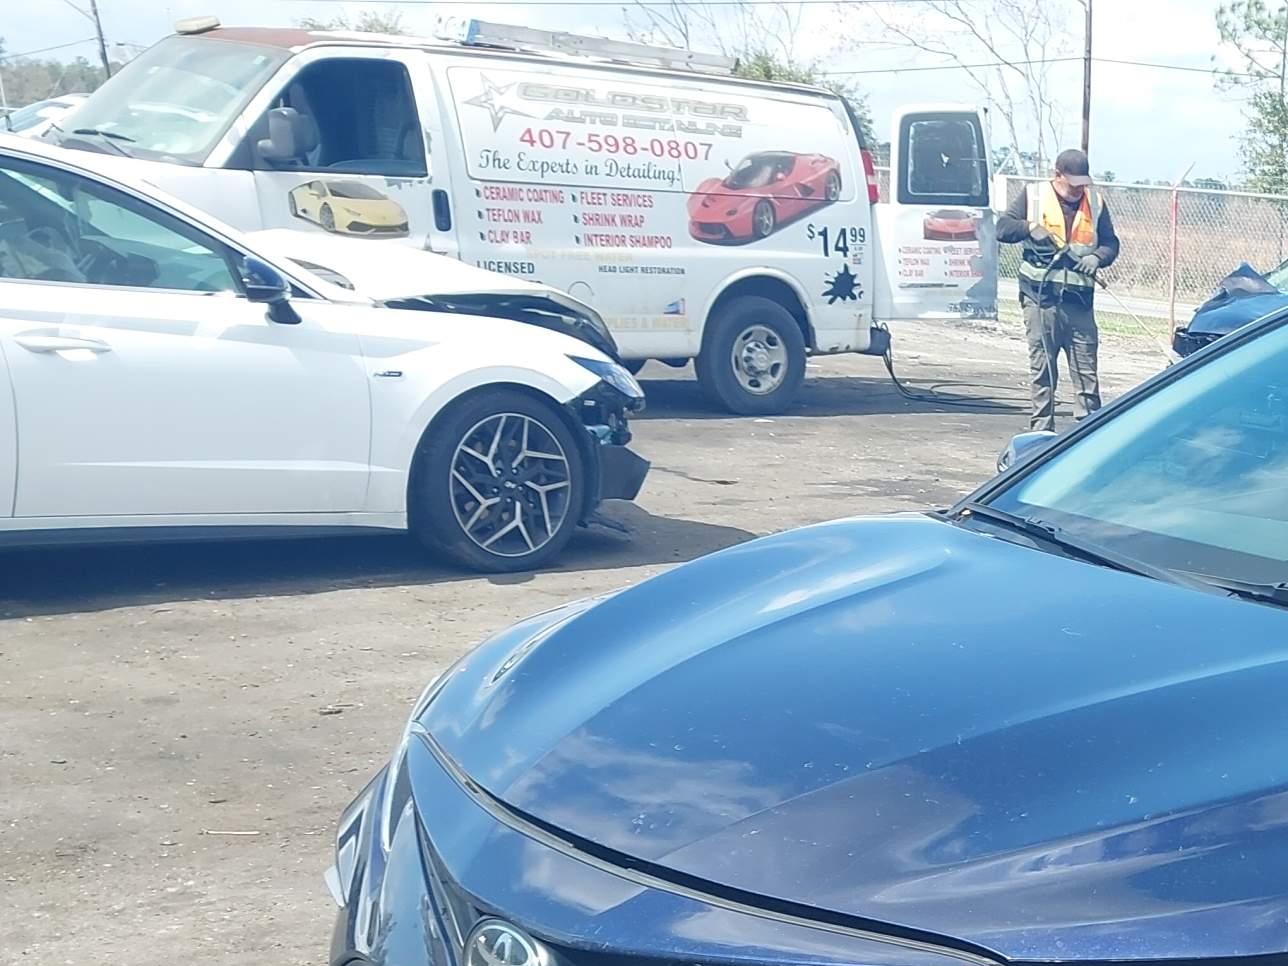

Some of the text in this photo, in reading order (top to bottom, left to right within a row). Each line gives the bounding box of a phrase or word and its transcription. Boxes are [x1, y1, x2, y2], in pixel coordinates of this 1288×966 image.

[519, 127, 713, 161] 407-598-0807
[479, 149, 681, 187] The Experts in Detailing!
[483, 186, 564, 204] CERAMIC COATING
[580, 191, 654, 208] FLEET SERVICES
[486, 208, 543, 224] TEFLON WAX
[582, 213, 645, 228] SHRINK WRAP
[487, 230, 532, 244] CLAY BAR
[583, 233, 672, 249] INTERIOR SHAMPOO
